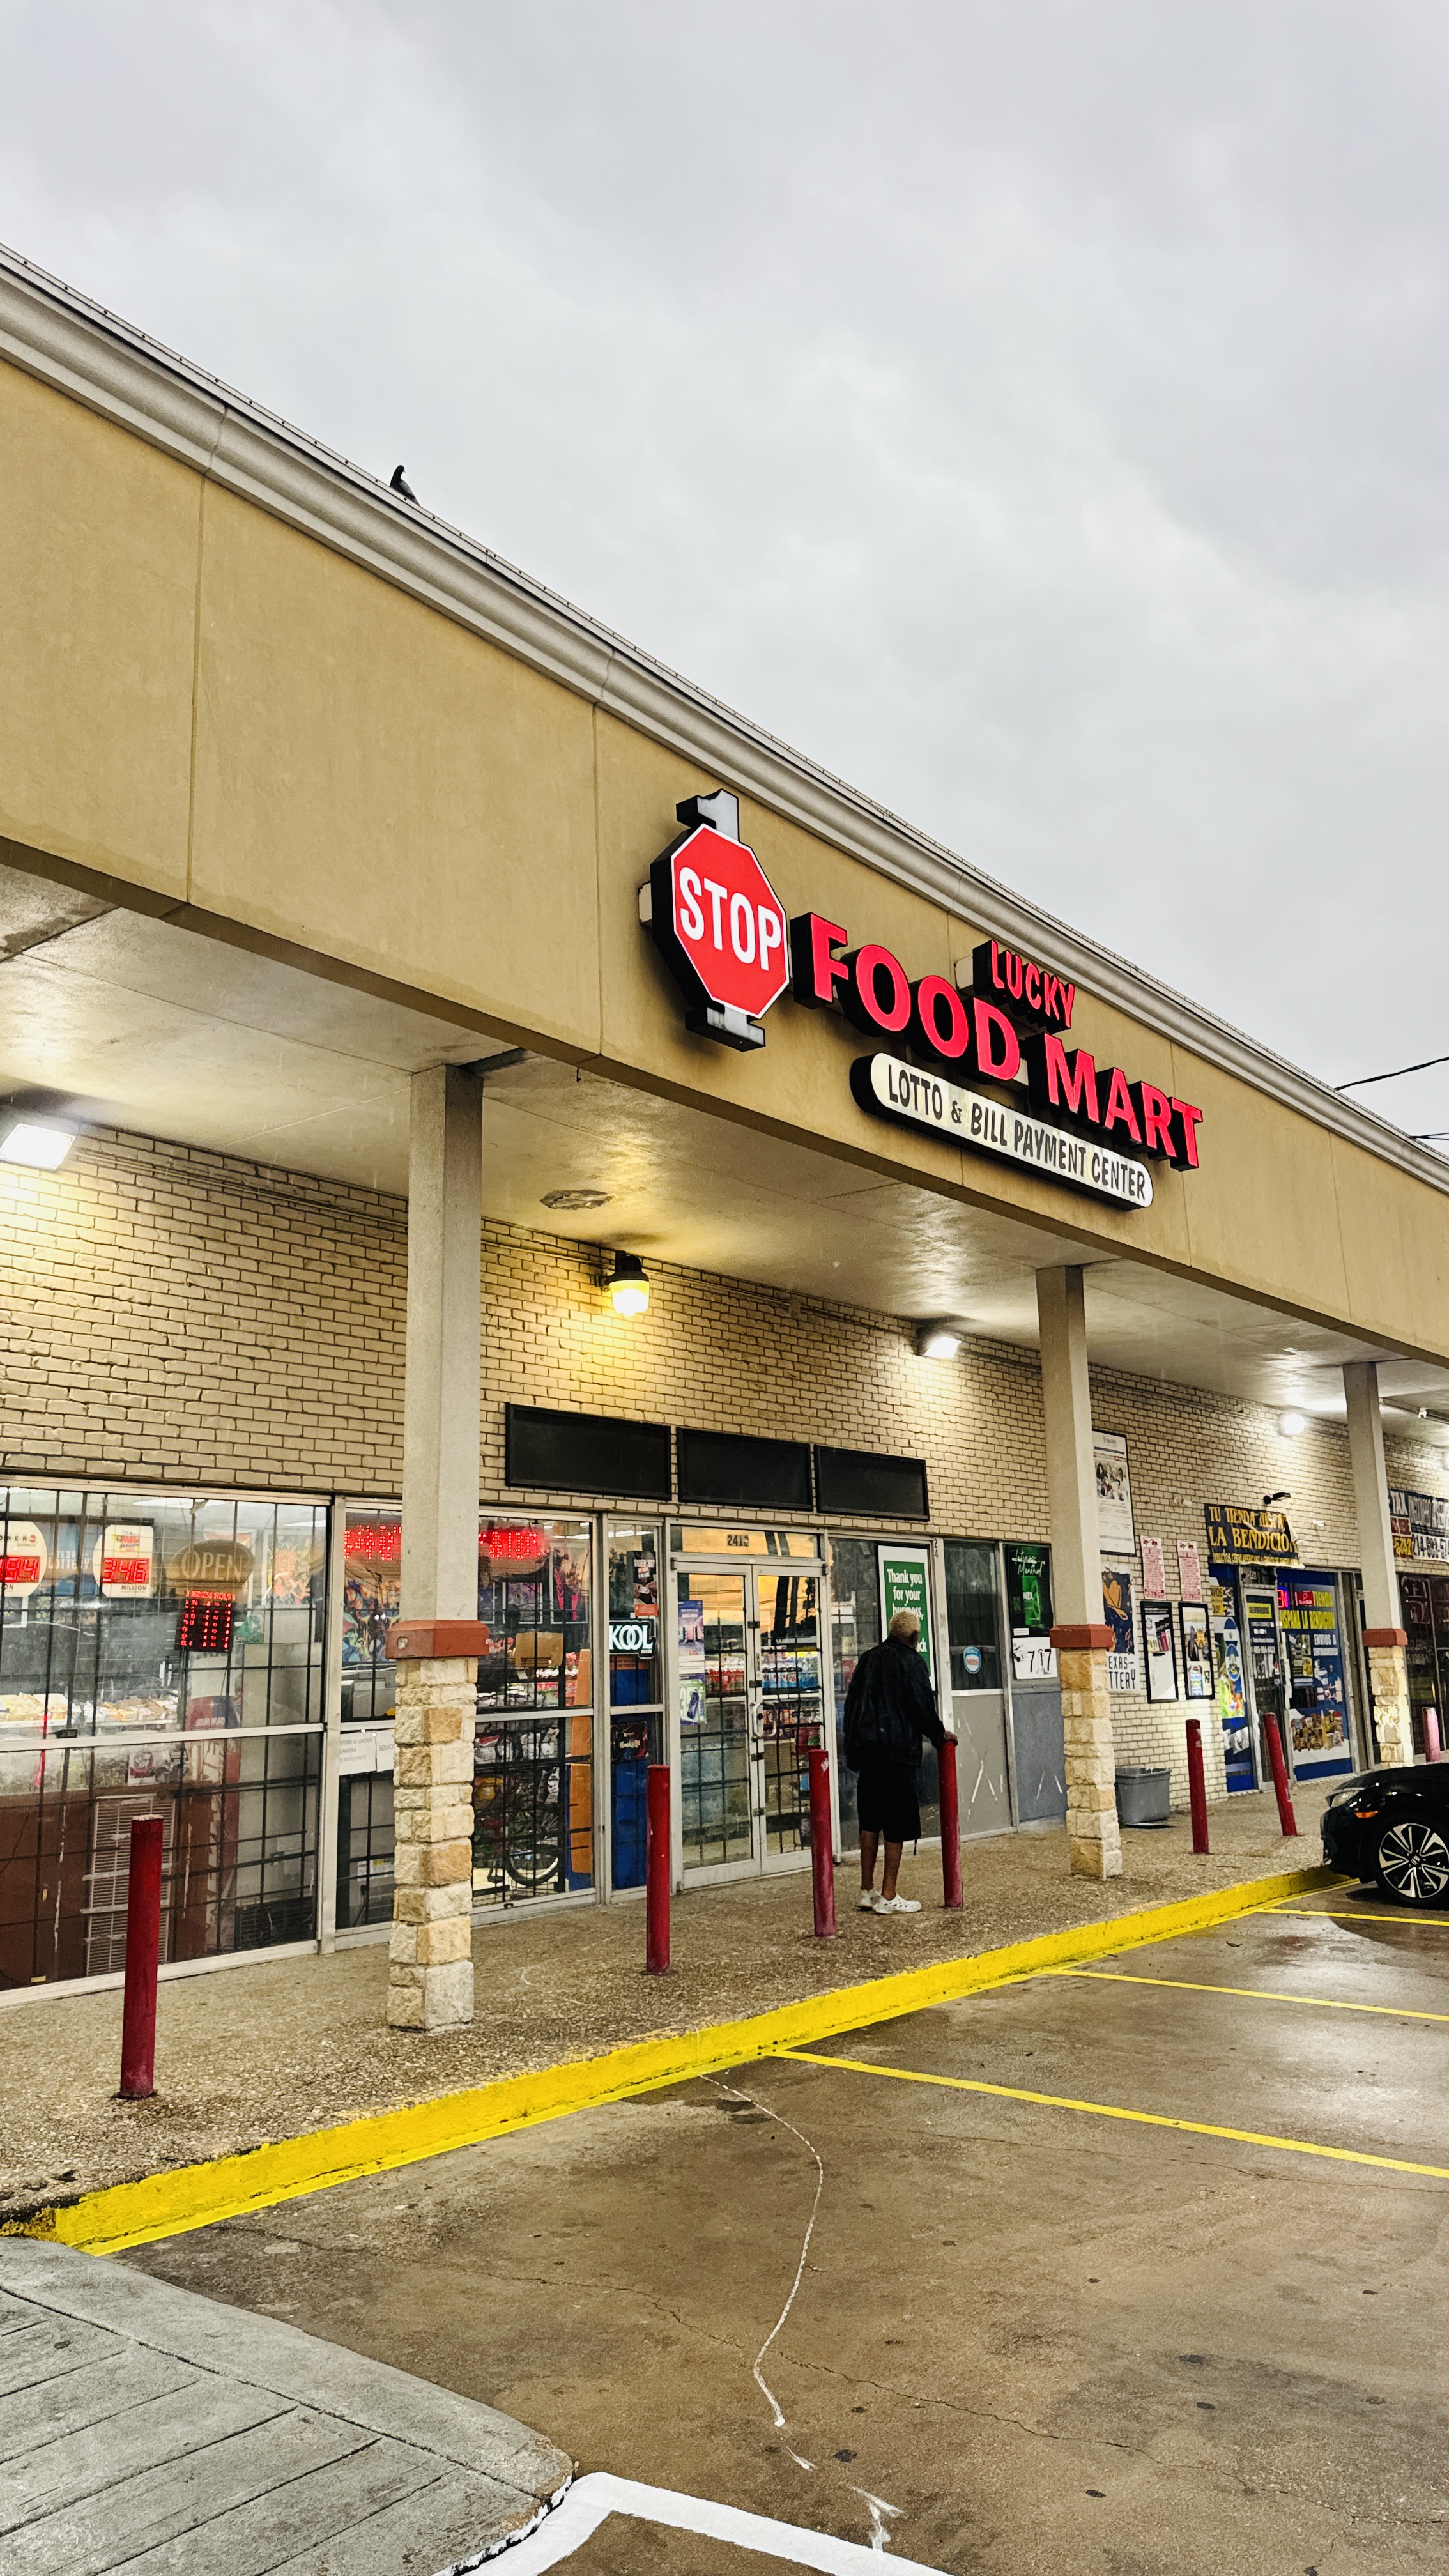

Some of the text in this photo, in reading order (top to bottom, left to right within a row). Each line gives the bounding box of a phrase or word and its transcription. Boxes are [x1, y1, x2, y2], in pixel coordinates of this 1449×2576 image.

[678, 866, 782, 972] STOP
[991, 939, 1075, 1029] LUCKY
[810, 912, 1203, 1169] FOOD MART
[888, 1064, 1146, 1200] LOTTO & BILL PAYMENT CENTER
[1208, 1506, 1222, 1522] TU
[1225, 1508, 1256, 1526] TIENDA
[1208, 1526, 1298, 1553] LA BENDICION
[0, 1558, 38, 1581] 94
[102, 1559, 148, 1583] 346
[181, 1549, 243, 1583] OPEN
[887, 1568, 923, 1588] Thank you
[893, 1585, 921, 1604] for your
[609, 1624, 654, 1650] KOOL
[1108, 1655, 1128, 1670] EXAS
[1108, 1669, 1136, 1690] TTERY
